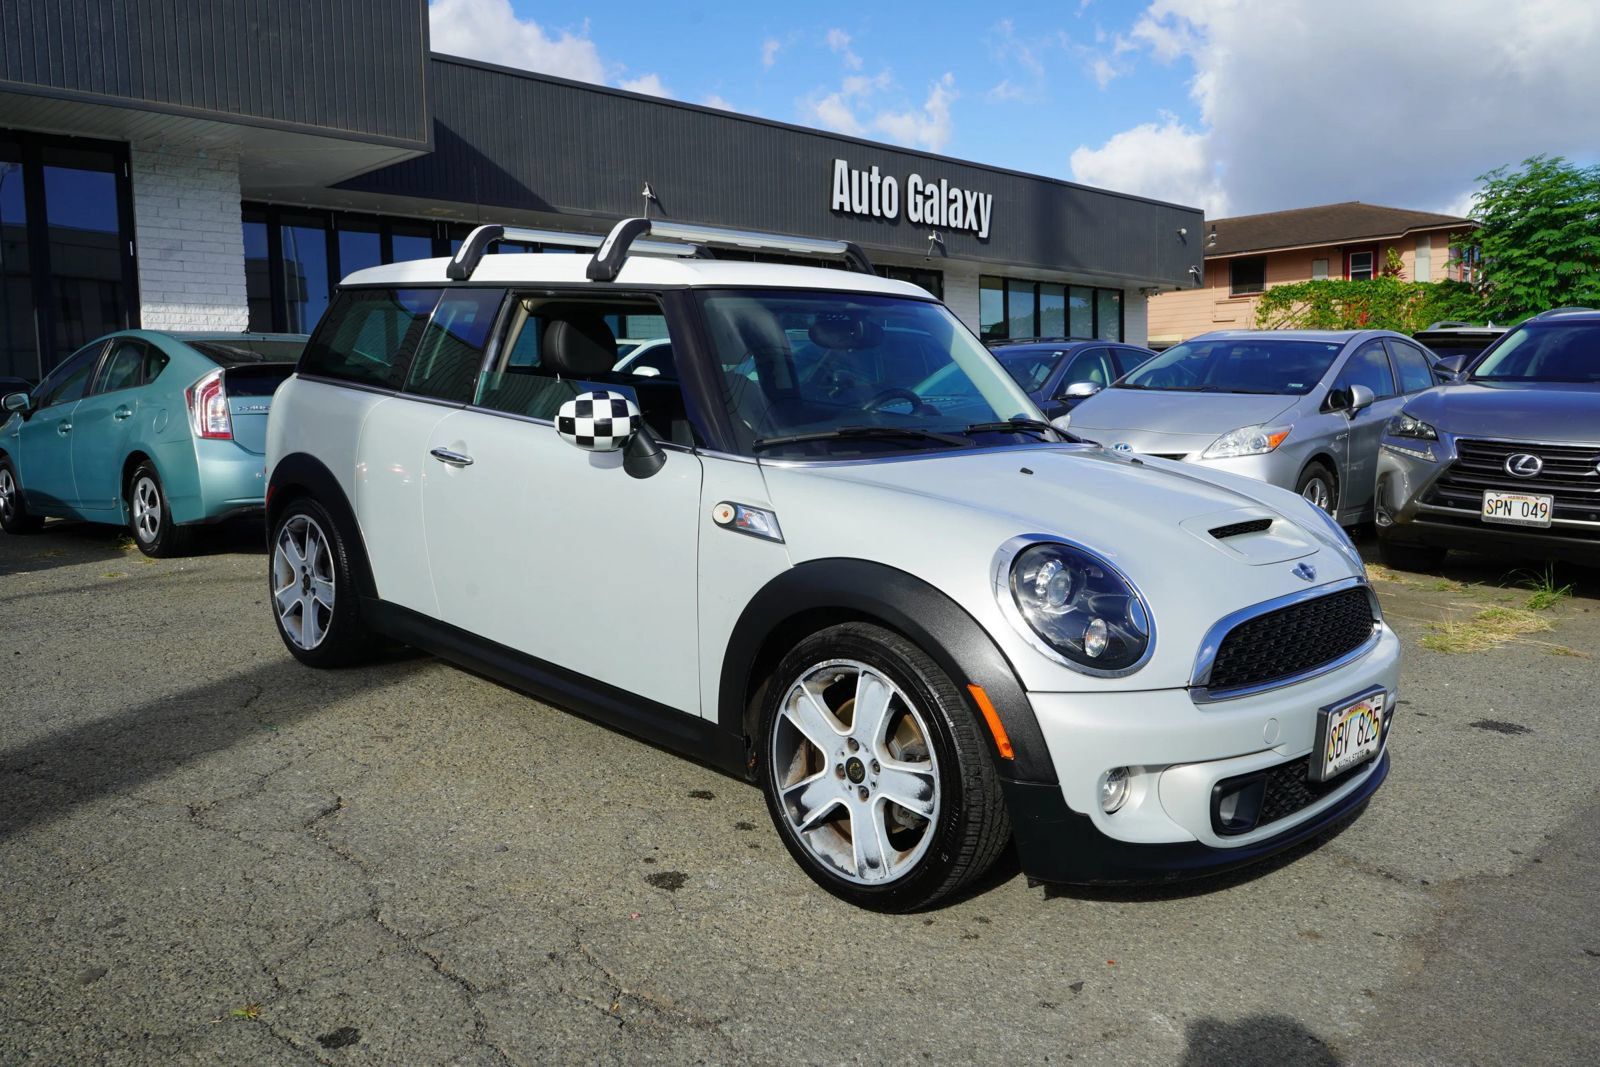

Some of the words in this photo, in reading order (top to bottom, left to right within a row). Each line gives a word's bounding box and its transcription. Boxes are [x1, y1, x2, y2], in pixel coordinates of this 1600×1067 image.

[832, 158, 899, 219] Auto
[907, 173, 993, 239] Galaxy
[1486, 499, 1513, 516] SPN
[1521, 501, 1548, 518] 049
[1328, 718, 1352, 761] SBV
[1357, 706, 1382, 747] 825
